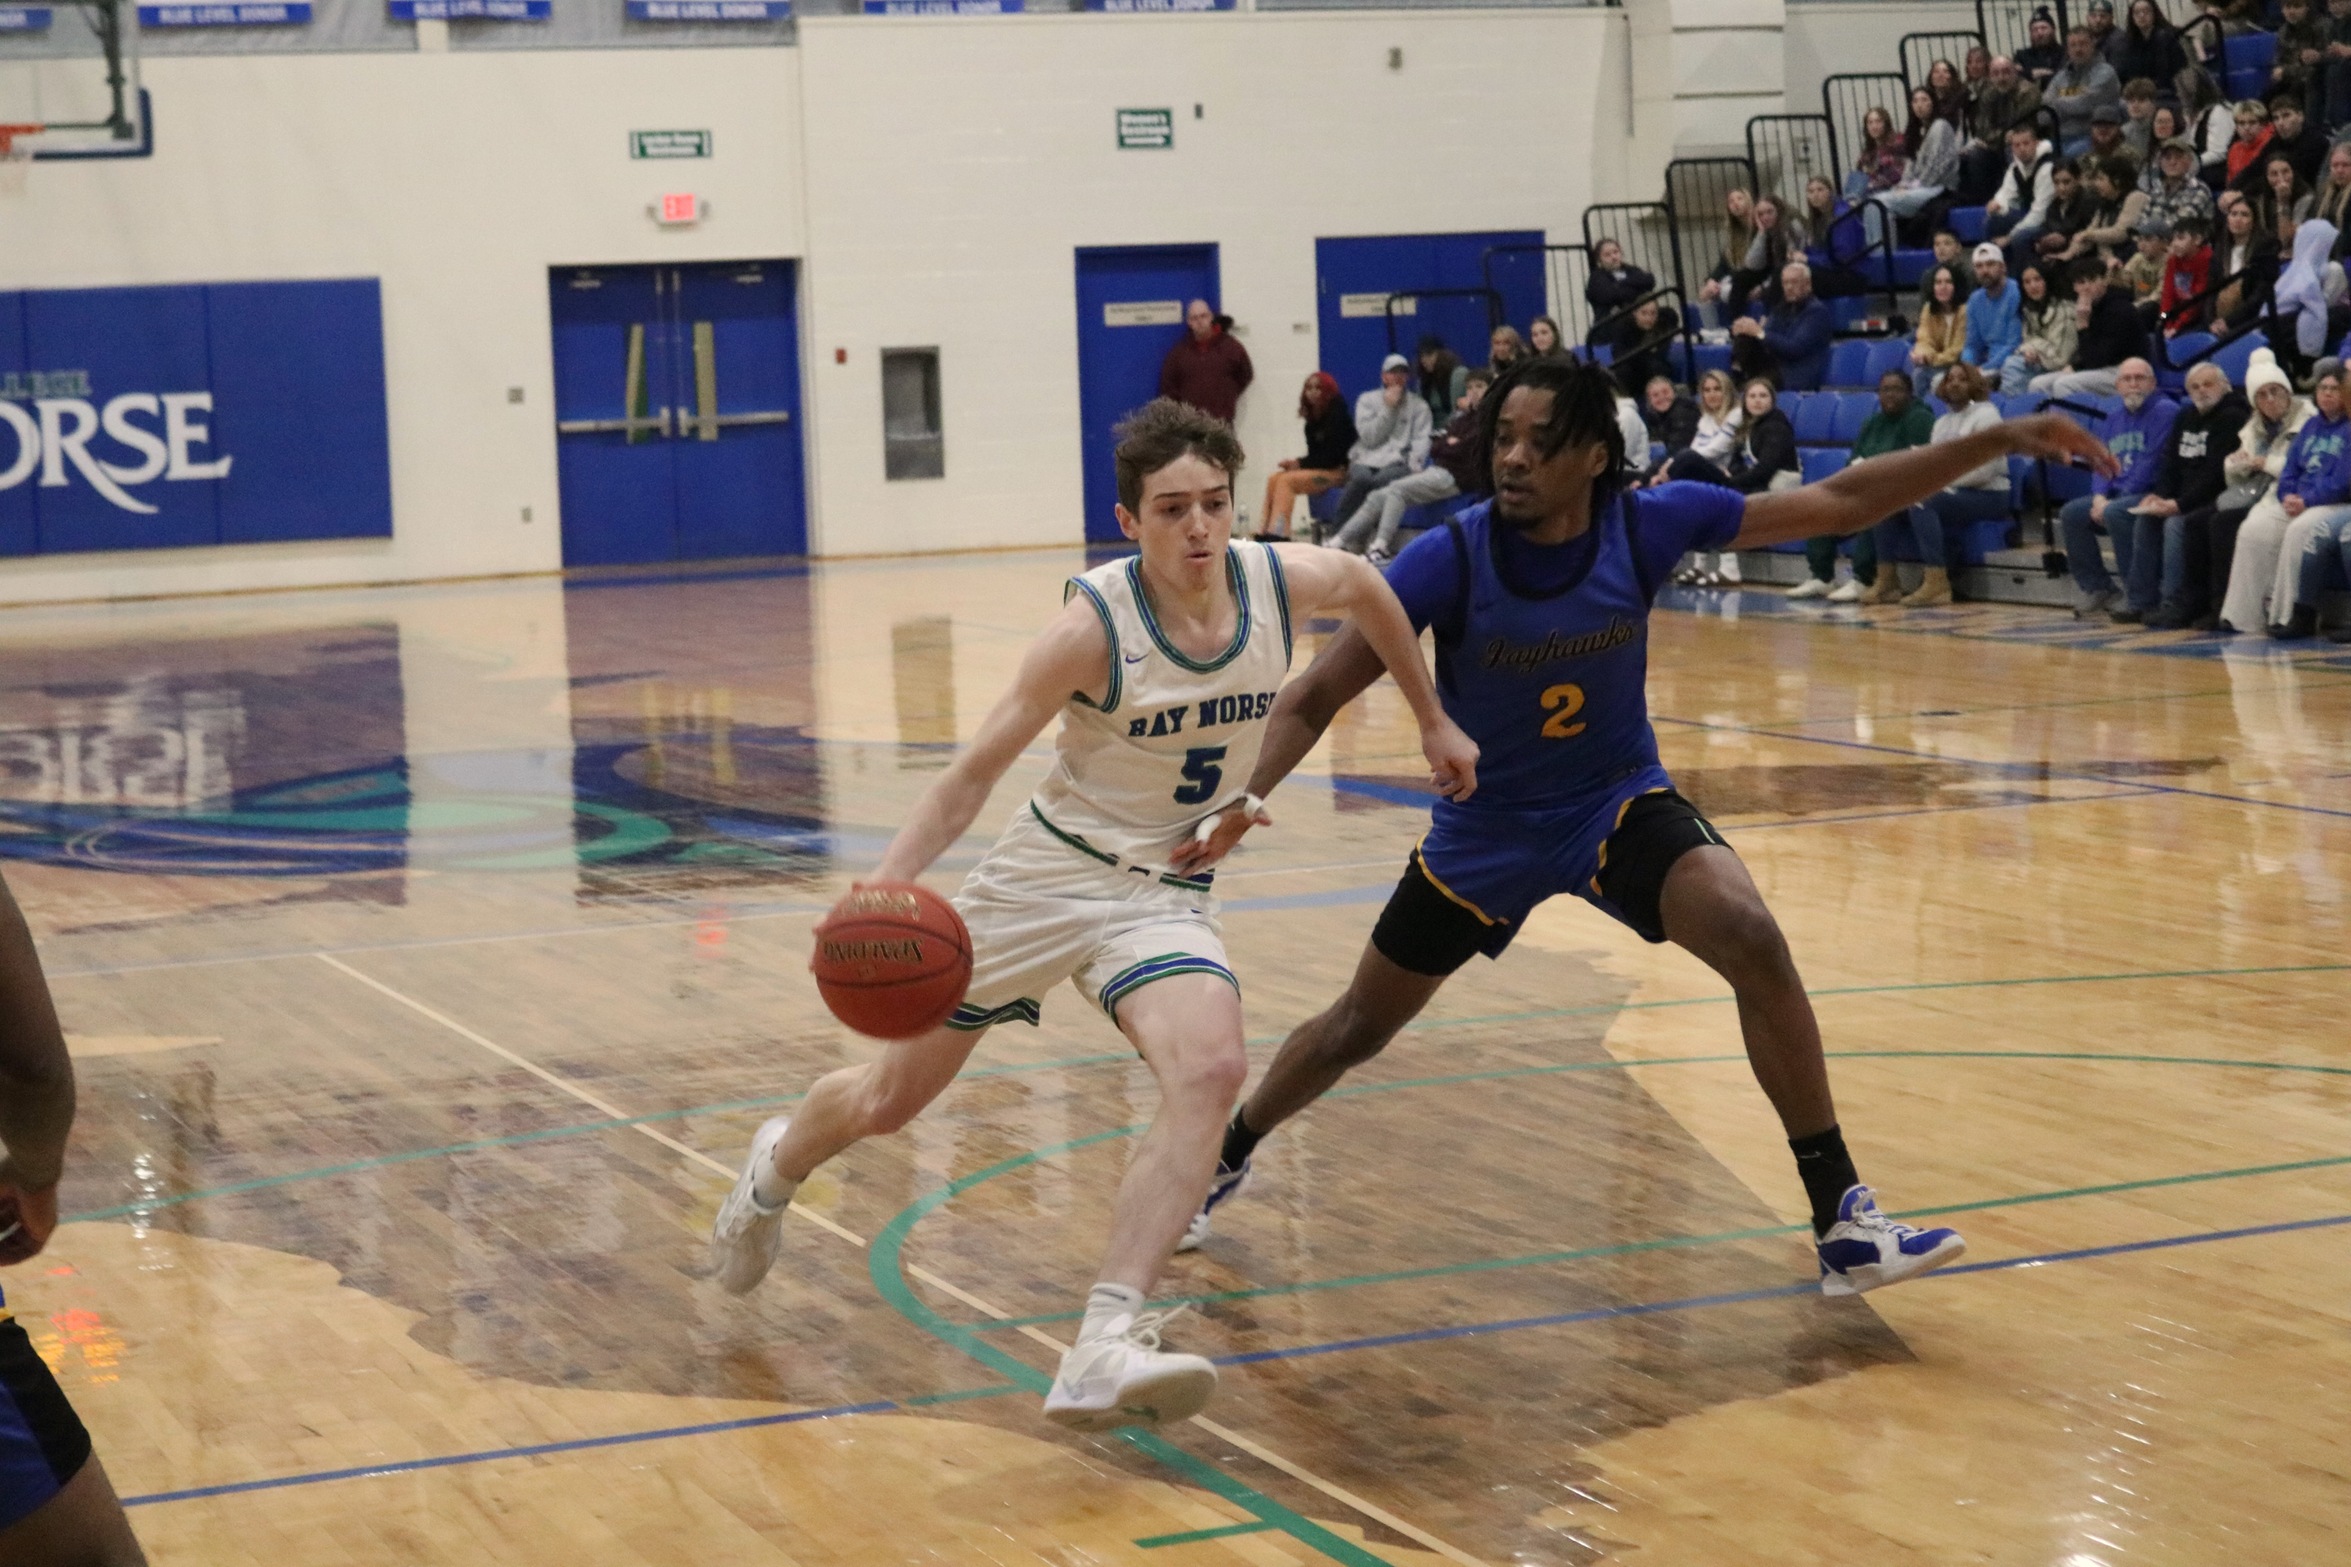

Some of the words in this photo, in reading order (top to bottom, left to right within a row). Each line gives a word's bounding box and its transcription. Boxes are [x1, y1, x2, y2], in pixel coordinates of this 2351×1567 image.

[1483, 615, 1636, 673] Jayhawks
[1128, 706, 1189, 737] BAY
[1539, 682, 1587, 738] 2
[1173, 745, 1228, 805] 5
